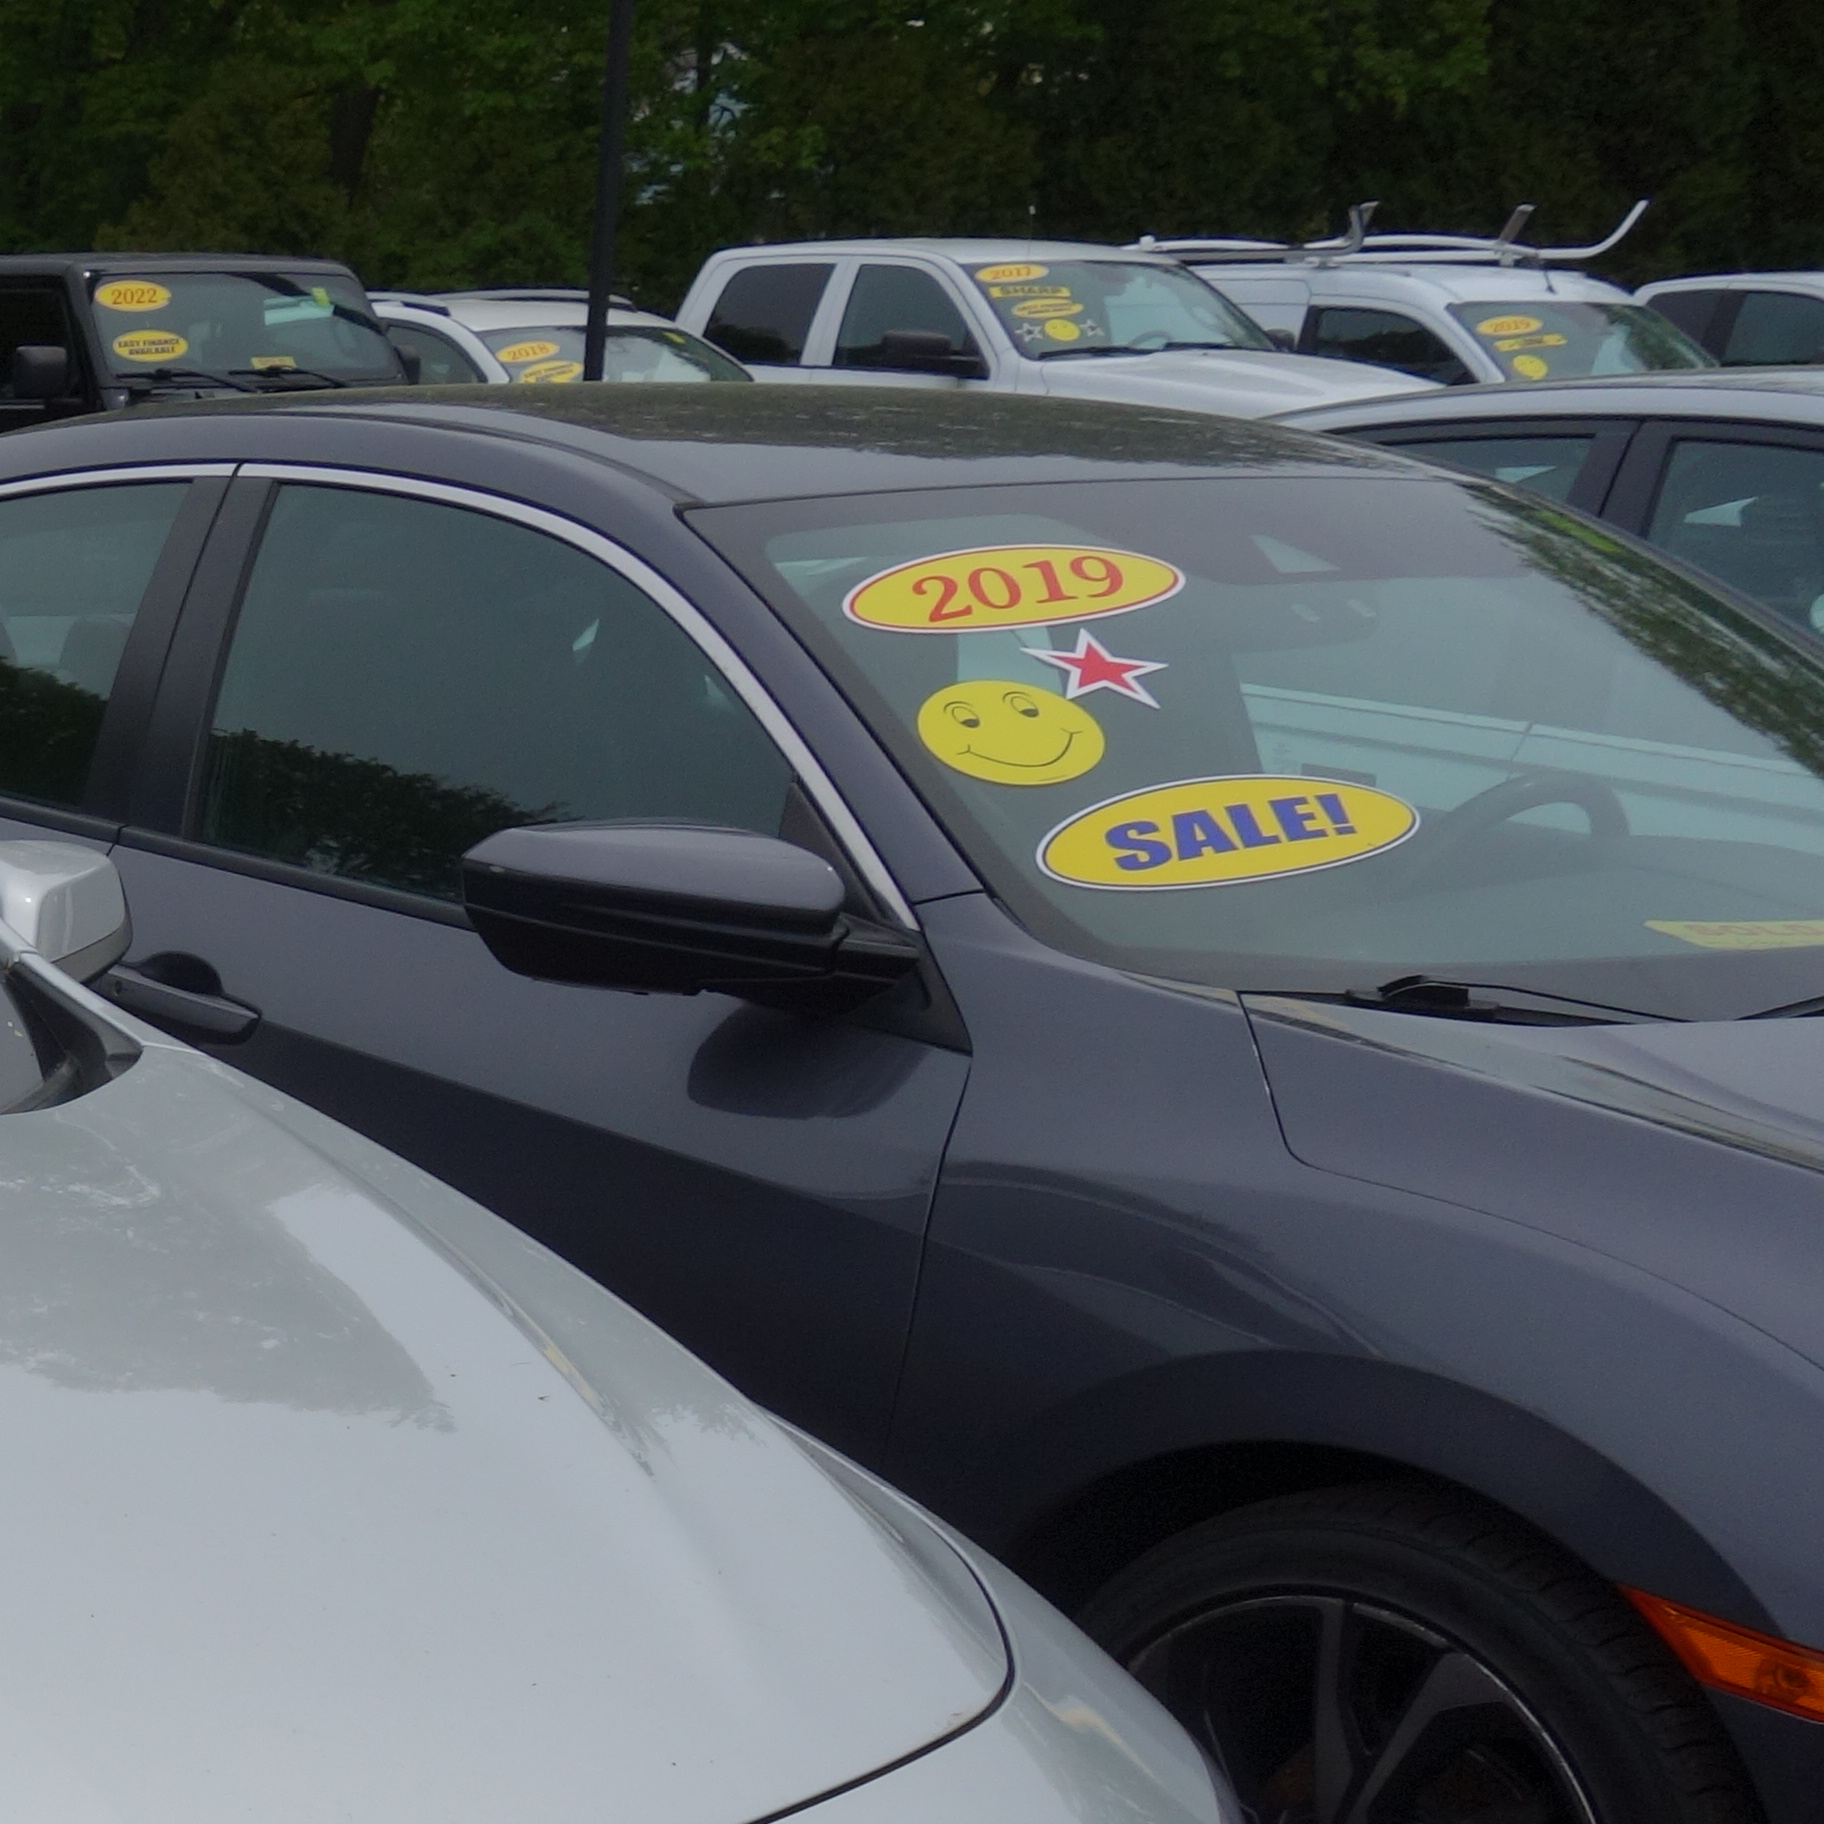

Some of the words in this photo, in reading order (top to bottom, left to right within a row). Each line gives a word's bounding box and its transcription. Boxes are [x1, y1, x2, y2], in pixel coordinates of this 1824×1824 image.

[990, 266, 1032, 280] 2017
[111, 288, 158, 305] 2022
[509, 343, 550, 360] 2018
[911, 555, 1124, 623] 2019
[1104, 793, 1358, 871] SALE!
